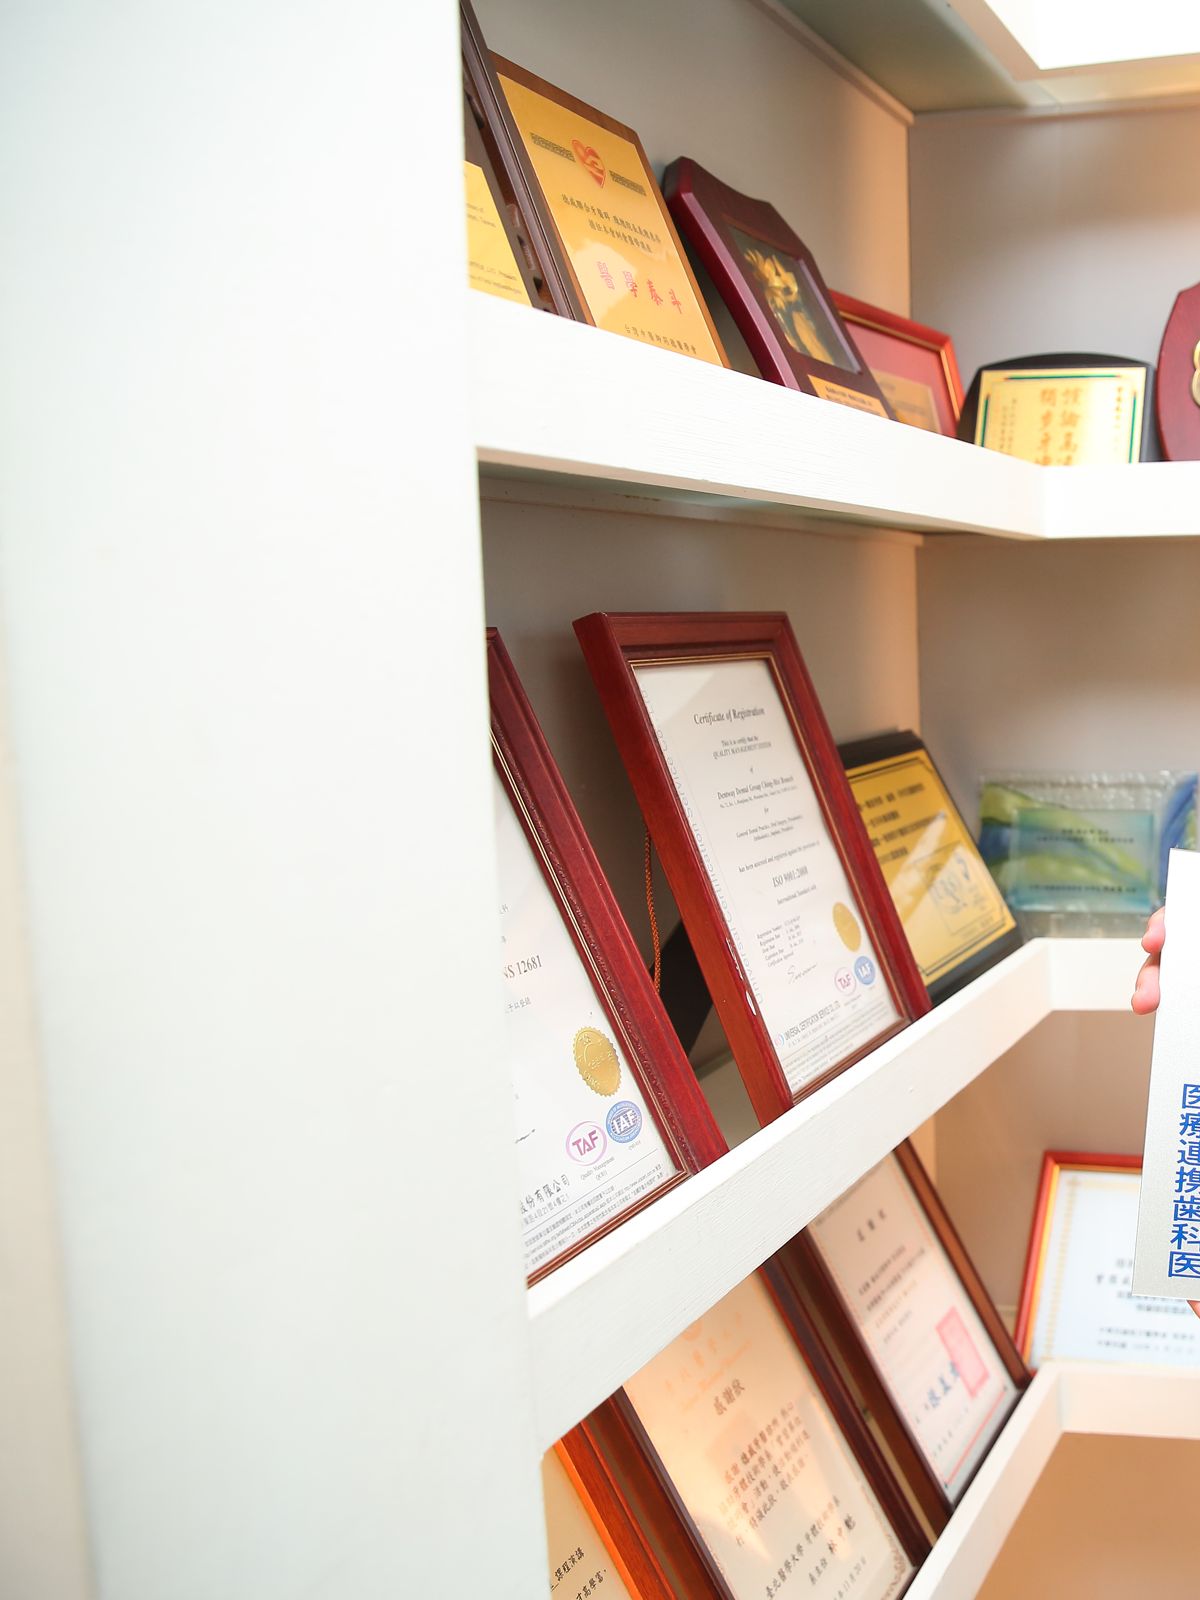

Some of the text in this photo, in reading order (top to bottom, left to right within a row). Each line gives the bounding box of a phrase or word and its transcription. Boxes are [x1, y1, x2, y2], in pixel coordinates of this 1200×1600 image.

[693, 707, 765, 726] Certificate of Registration
[772, 874, 784, 889] ISO
[516, 955, 542, 975] 12681
[611, 1109, 638, 1135] IAF
[572, 1129, 599, 1157] TAF
[713, 1378, 746, 1416] 感謝狀
